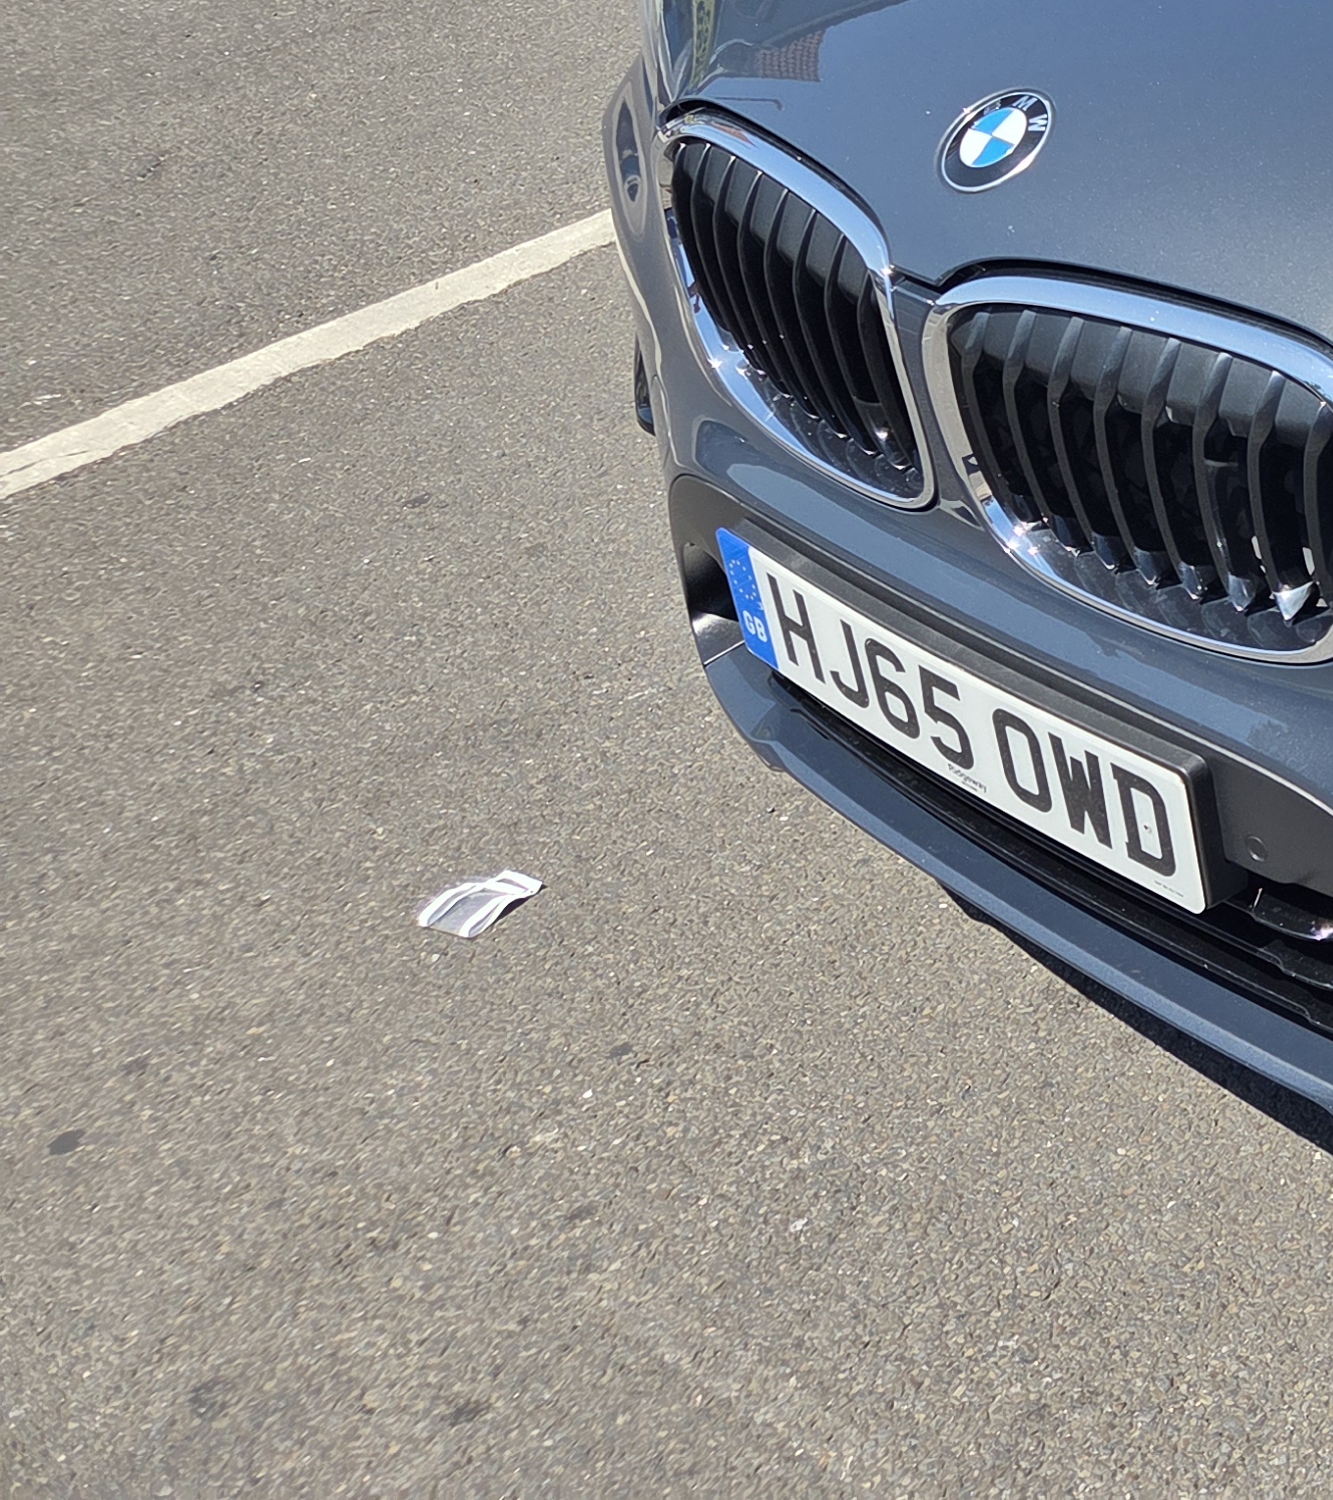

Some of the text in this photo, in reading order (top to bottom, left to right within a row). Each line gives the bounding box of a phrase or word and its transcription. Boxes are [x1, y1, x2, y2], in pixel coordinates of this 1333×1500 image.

[742, 609, 768, 643] GB
[767, 572, 1177, 877] HJ65 OWD
